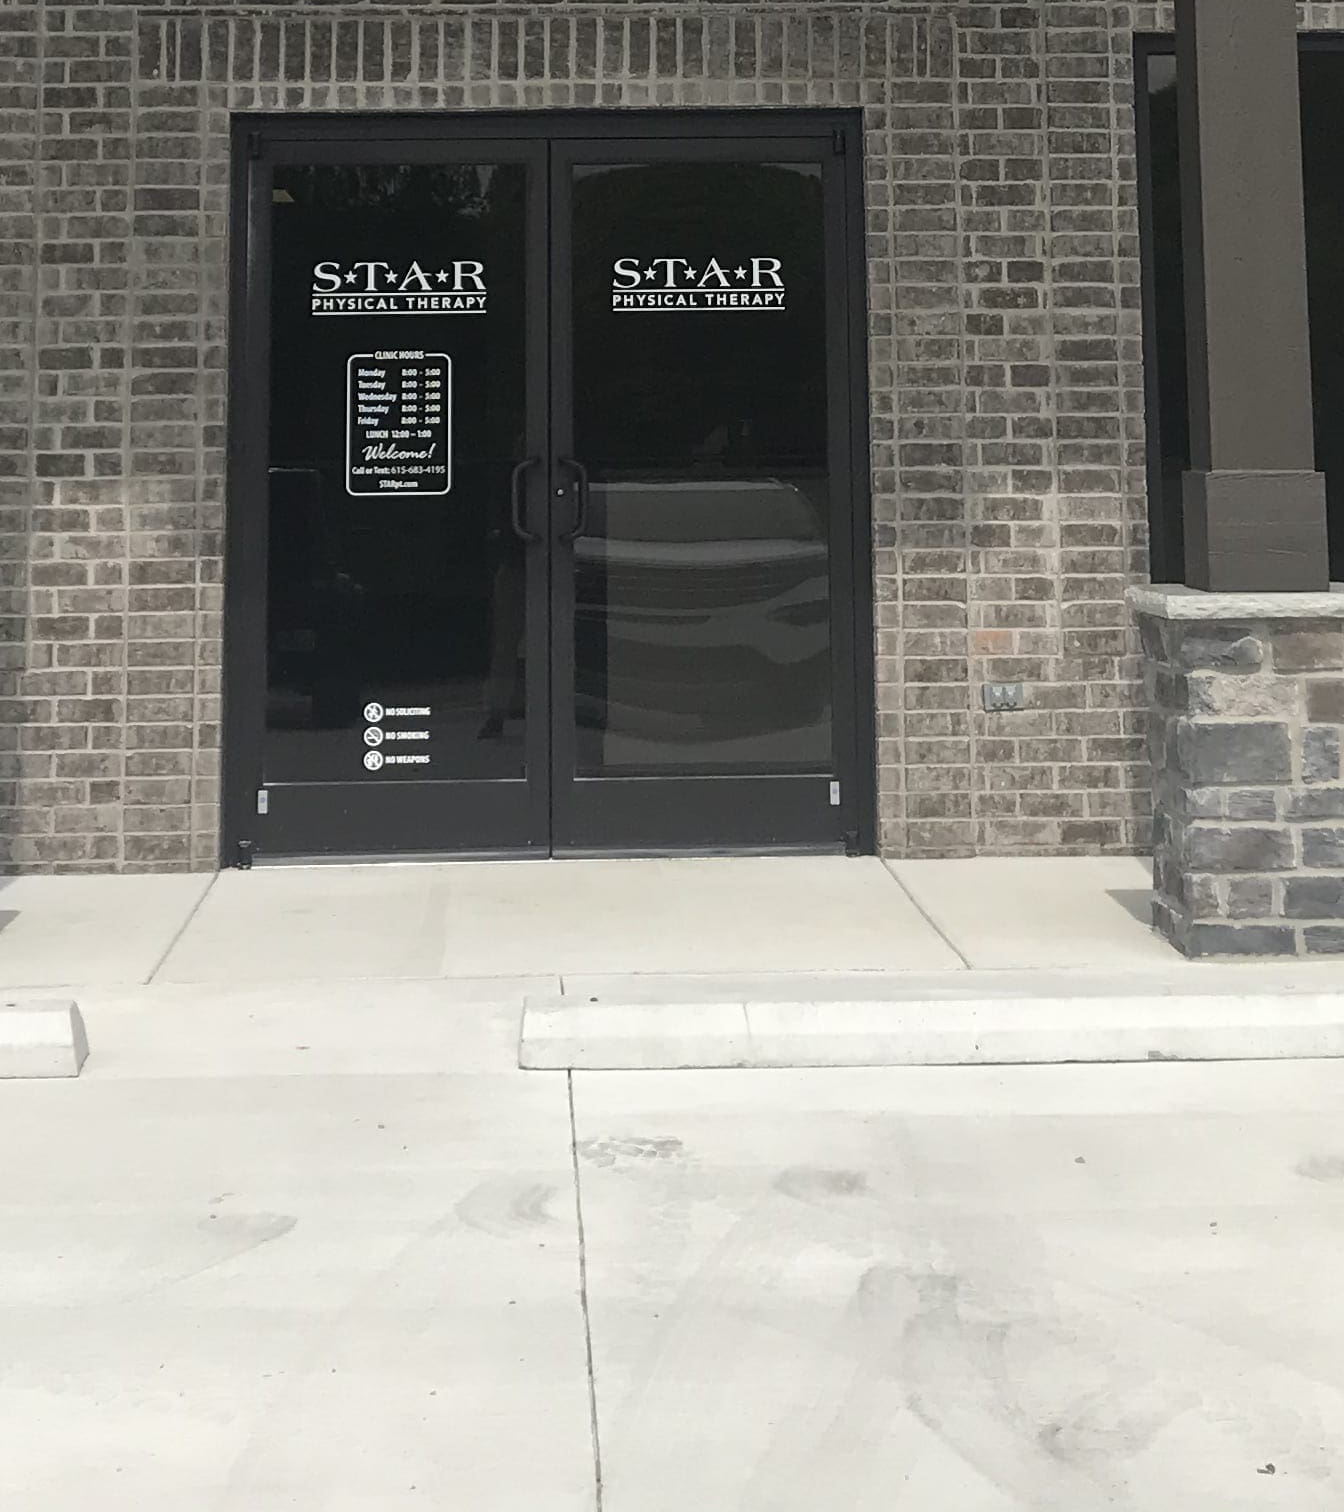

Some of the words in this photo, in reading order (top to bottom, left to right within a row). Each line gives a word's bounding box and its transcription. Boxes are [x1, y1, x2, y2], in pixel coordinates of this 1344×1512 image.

[312, 298, 398, 311] PHYSICAL
[406, 296, 487, 310] THERAPY
[612, 294, 698, 307] PHYSICAL
[705, 292, 785, 306] THERAPY
[374, 351, 398, 360] CLINIC
[399, 350, 425, 360] HOURS
[358, 369, 386, 379] Monday
[358, 381, 386, 391] Tuesday
[358, 392, 397, 402] Wednesday
[358, 404, 389, 414] Thursday
[358, 416, 379, 426] Friday
[366, 430, 389, 439] LUNCH
[362, 442, 437, 461] Welcome!
[352, 466, 365, 475] Call
[366, 467, 373, 475] or
[391, 465, 446, 475] 615-683-4195
[385, 707, 395, 716] NO
[385, 731, 396, 740] NO
[385, 755, 396, 764] NO
